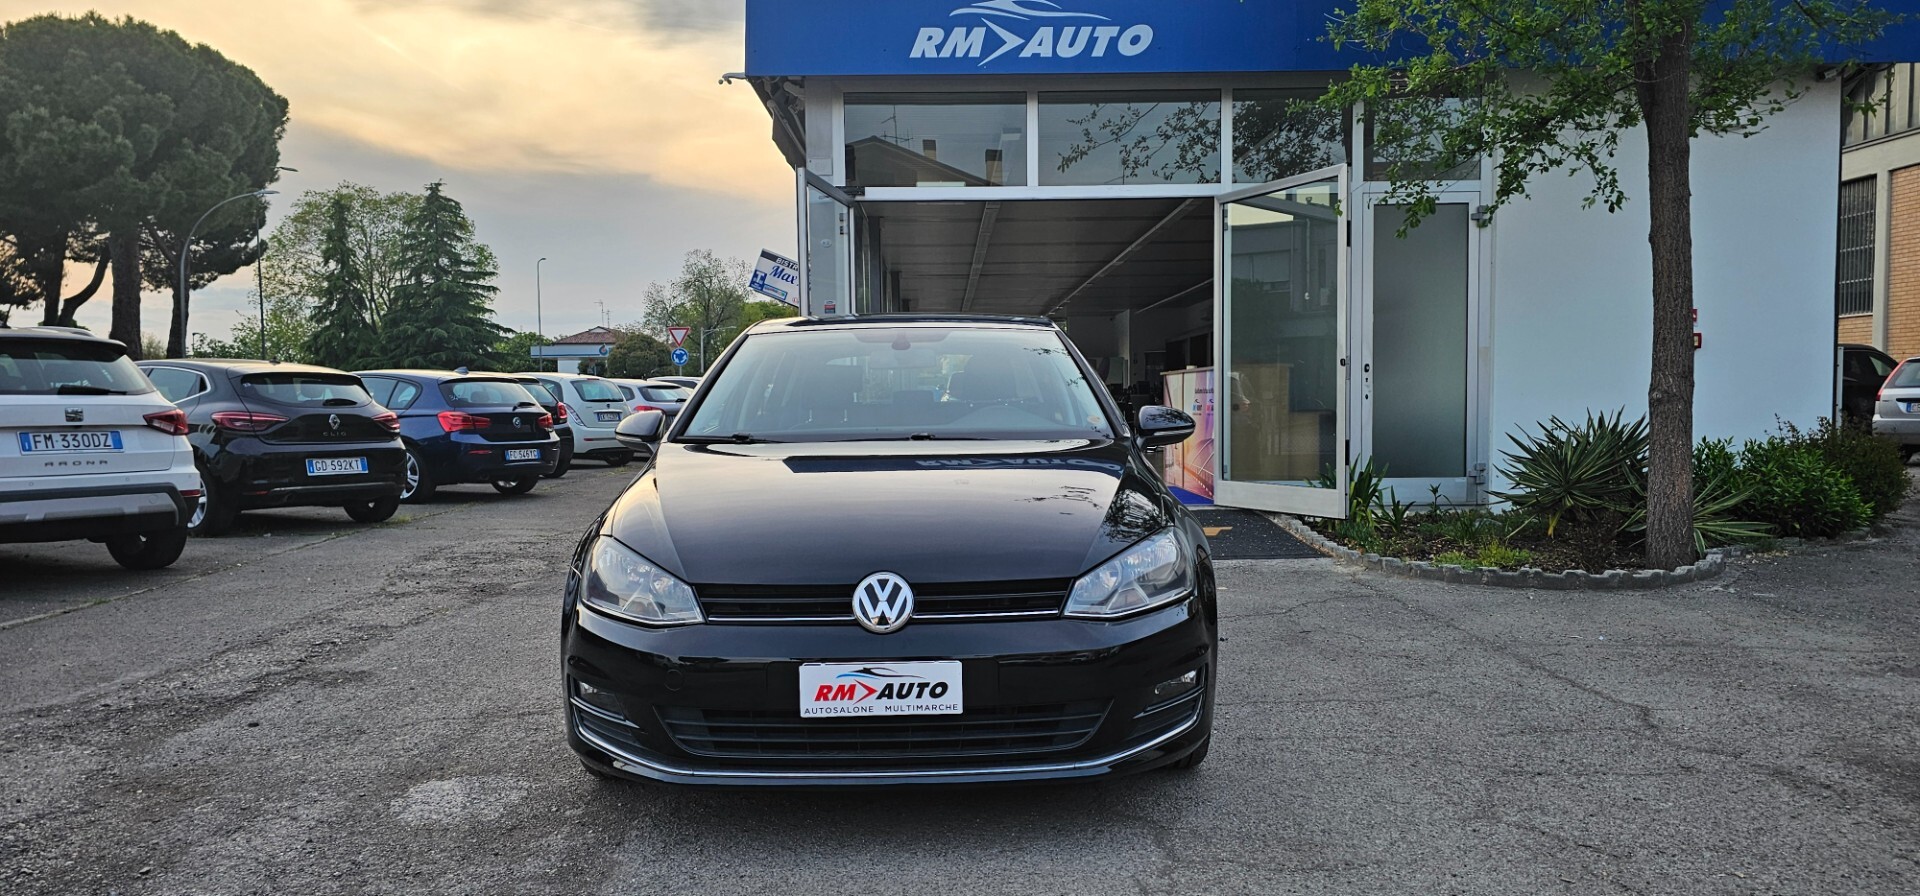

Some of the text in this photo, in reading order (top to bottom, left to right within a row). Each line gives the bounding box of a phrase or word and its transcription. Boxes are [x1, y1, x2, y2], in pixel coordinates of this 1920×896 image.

[909, 24, 1154, 58] RM AUTO
[775, 257, 799, 272] BISTR
[32, 432, 112, 449] FM 330DZ
[314, 459, 360, 472] GD 592KT
[814, 681, 949, 702] RM AUTO
[804, 703, 959, 715] AUTOSALONE MULTIMARCHE
